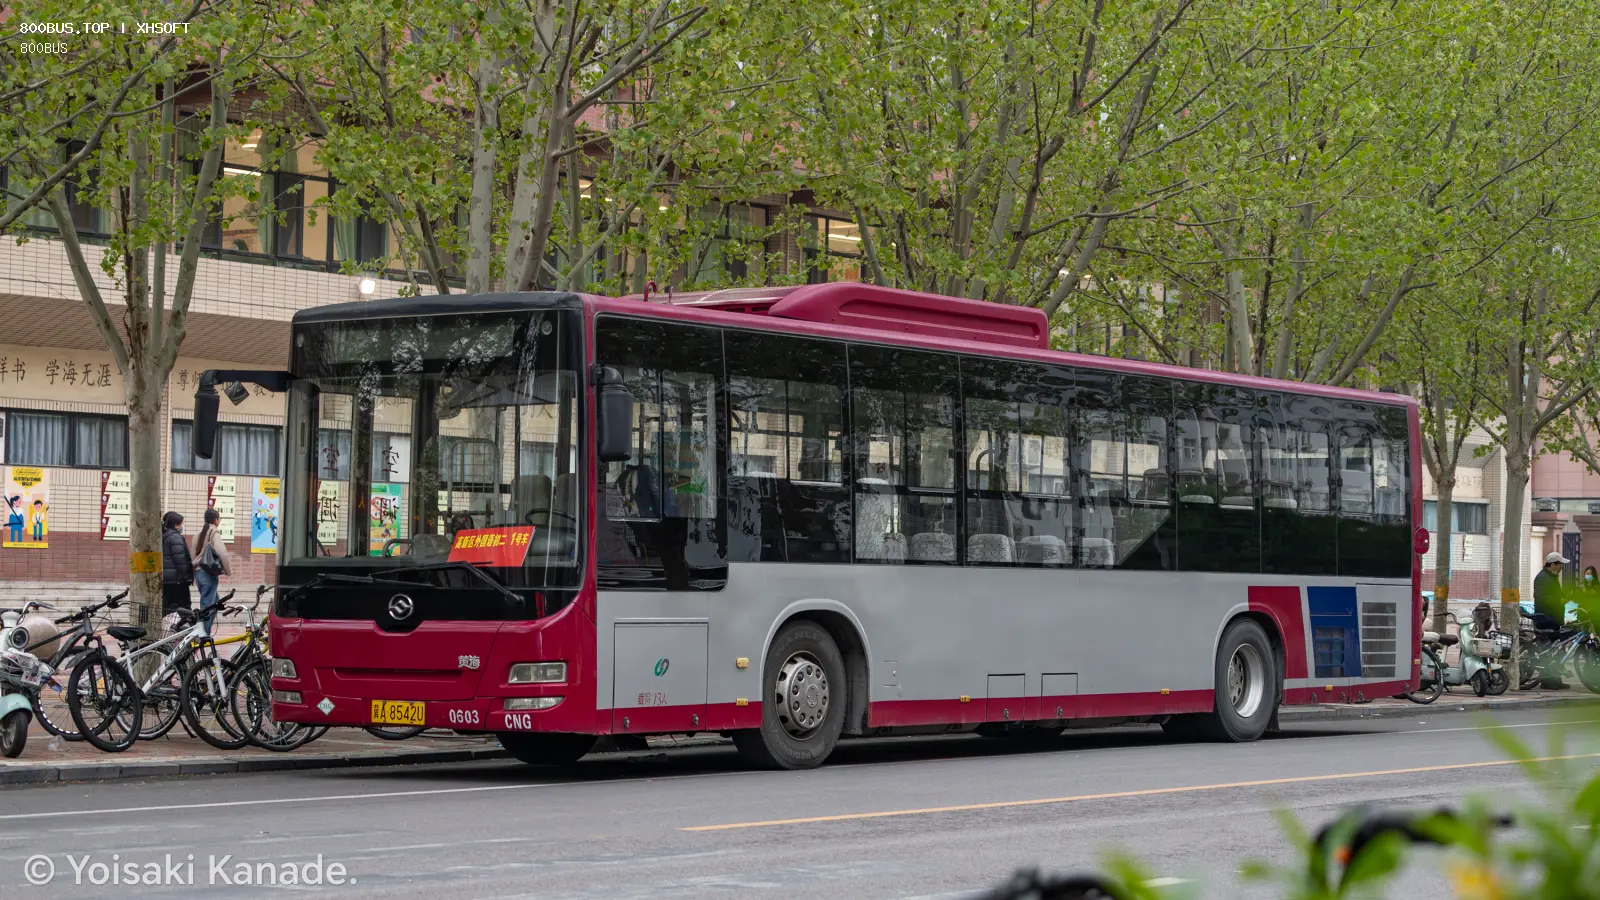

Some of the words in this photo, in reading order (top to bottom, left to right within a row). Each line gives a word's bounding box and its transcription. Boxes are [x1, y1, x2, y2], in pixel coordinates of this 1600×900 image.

[45, 359, 112, 388] 学海无涯
[457, 654, 481, 670] 黄海
[448, 708, 480, 725] 0603
[504, 713, 533, 730] CNG
